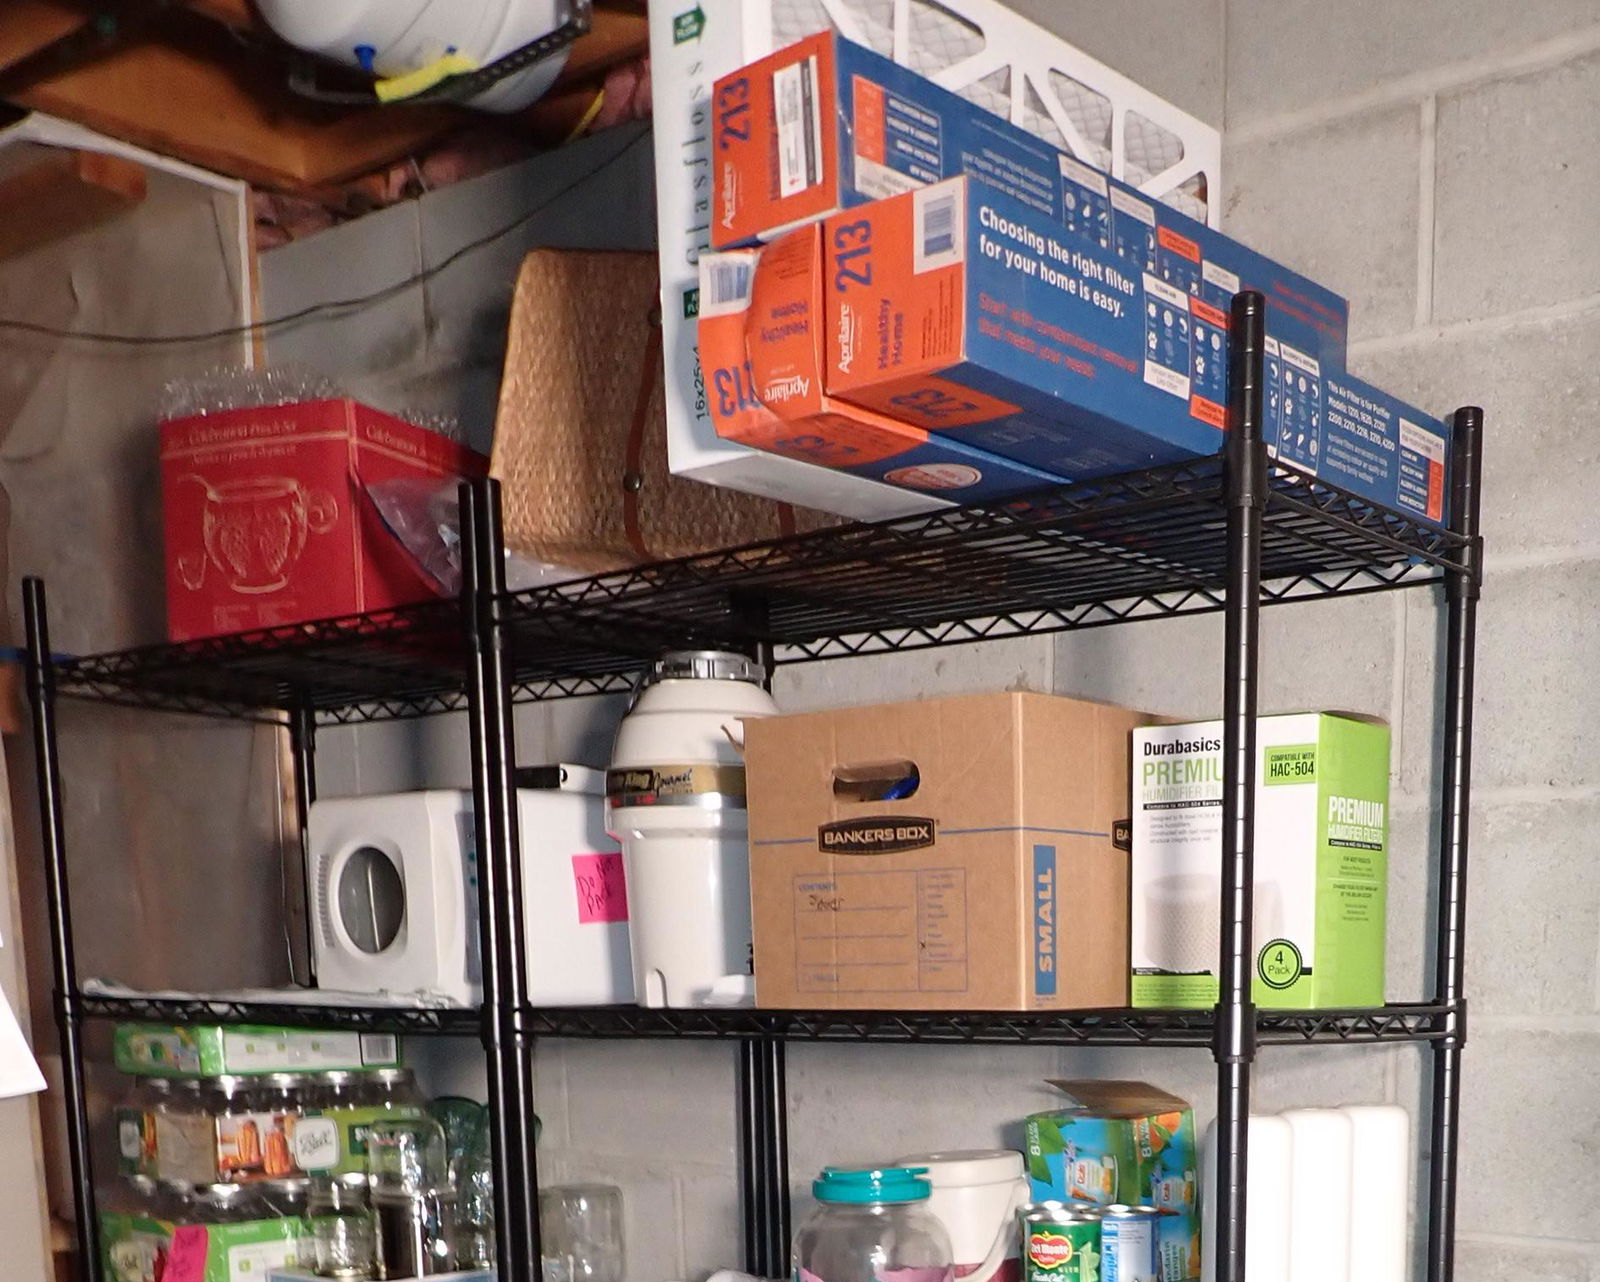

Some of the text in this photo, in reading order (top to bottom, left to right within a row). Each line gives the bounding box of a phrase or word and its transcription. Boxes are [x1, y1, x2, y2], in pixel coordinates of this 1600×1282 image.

[719, 77, 749, 150] 213
[682, 60, 711, 265] Glasfloss
[834, 219, 873, 293] 213
[980, 205, 1135, 296] Choosing the right filter
[980, 234, 1125, 318] for your home is easy.
[838, 302, 854, 374] Aprilaire
[892, 313, 903, 366] Home
[764, 375, 810, 404] Aprilaire
[1144, 737, 1221, 756] Durabasics
[1270, 751, 1315, 762] COMPATIBLE WITH
[1143, 757, 1223, 786] PREMIU
[1270, 761, 1315, 777] HAC-504
[1142, 783, 1223, 801] HUMIDIFIER FIL
[1328, 795, 1384, 828] PREMIUM
[824, 825, 931, 846] BANKERS BOX
[577, 875, 595, 896] Do
[1039, 867, 1053, 972] SMALL
[1274, 950, 1284, 964] 4
[1267, 963, 1291, 976] Pack
[1030, 1146, 1041, 1156] 8
[1141, 1147, 1152, 1158] 8
[1077, 1164, 1086, 1185] Dole
[1031, 1243, 1069, 1255] Del Monte
